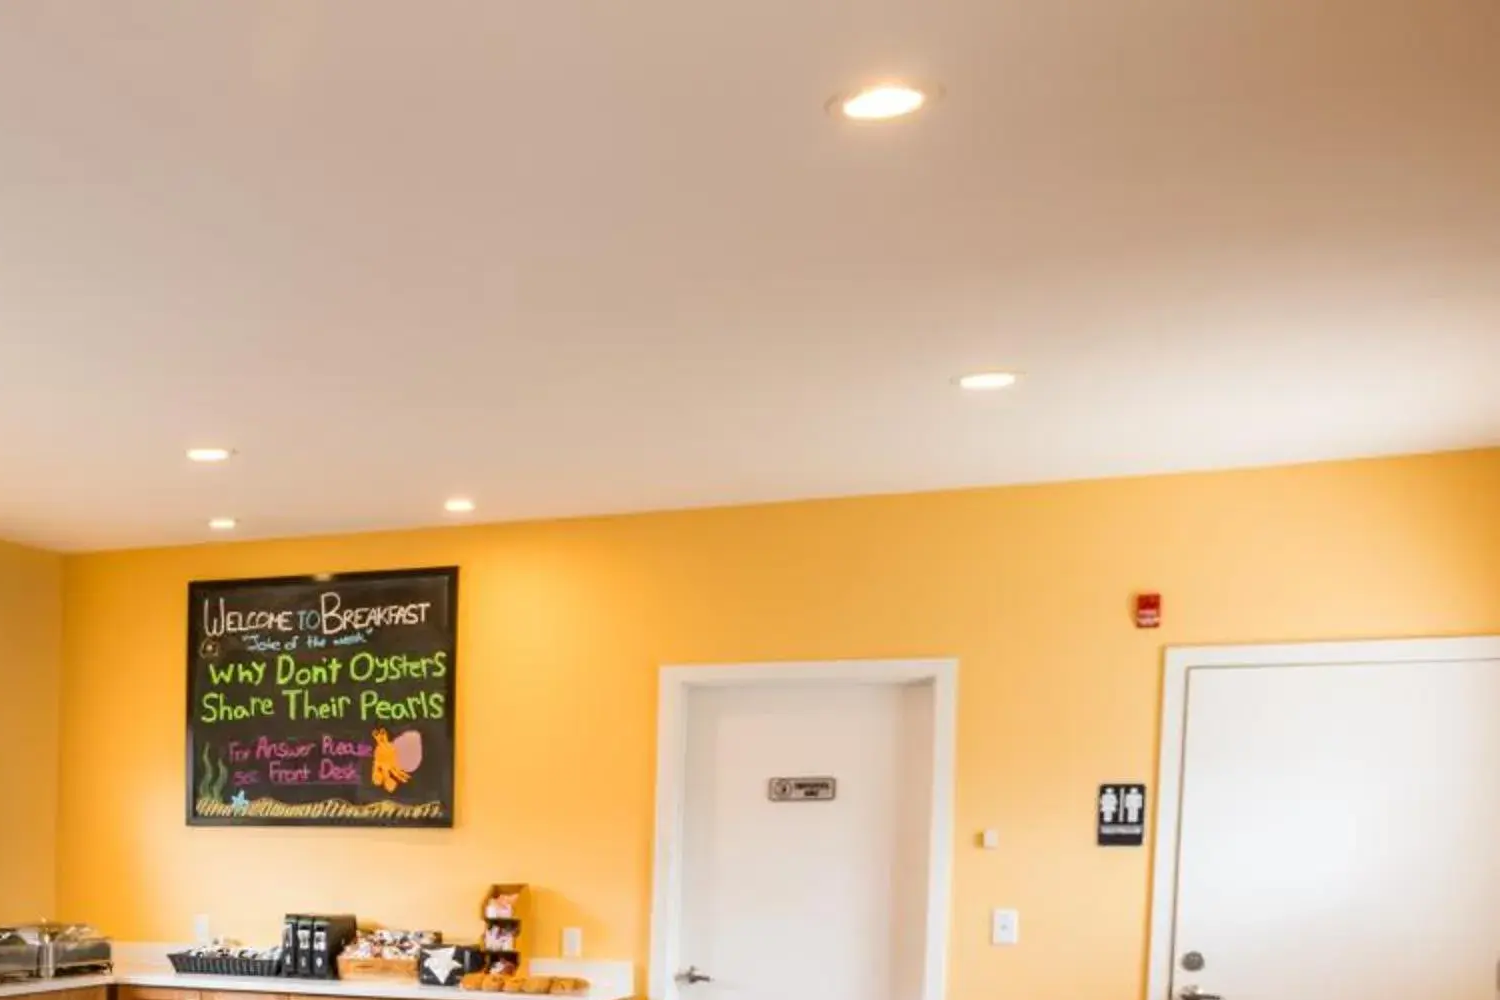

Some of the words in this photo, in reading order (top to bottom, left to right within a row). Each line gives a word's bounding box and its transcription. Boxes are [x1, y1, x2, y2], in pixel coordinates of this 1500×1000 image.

[203, 597, 293, 637] WELCOME
[297, 610, 321, 632] TO
[321, 592, 431, 635] BREAKFAST
[276, 654, 343, 686] Don't
[350, 651, 448, 683] Oysters
[201, 692, 275, 723] Share
[281, 689, 351, 721] Their
[360, 689, 445, 721] Pearls
[256, 736, 316, 760] Answer
[269, 760, 310, 781] Front
